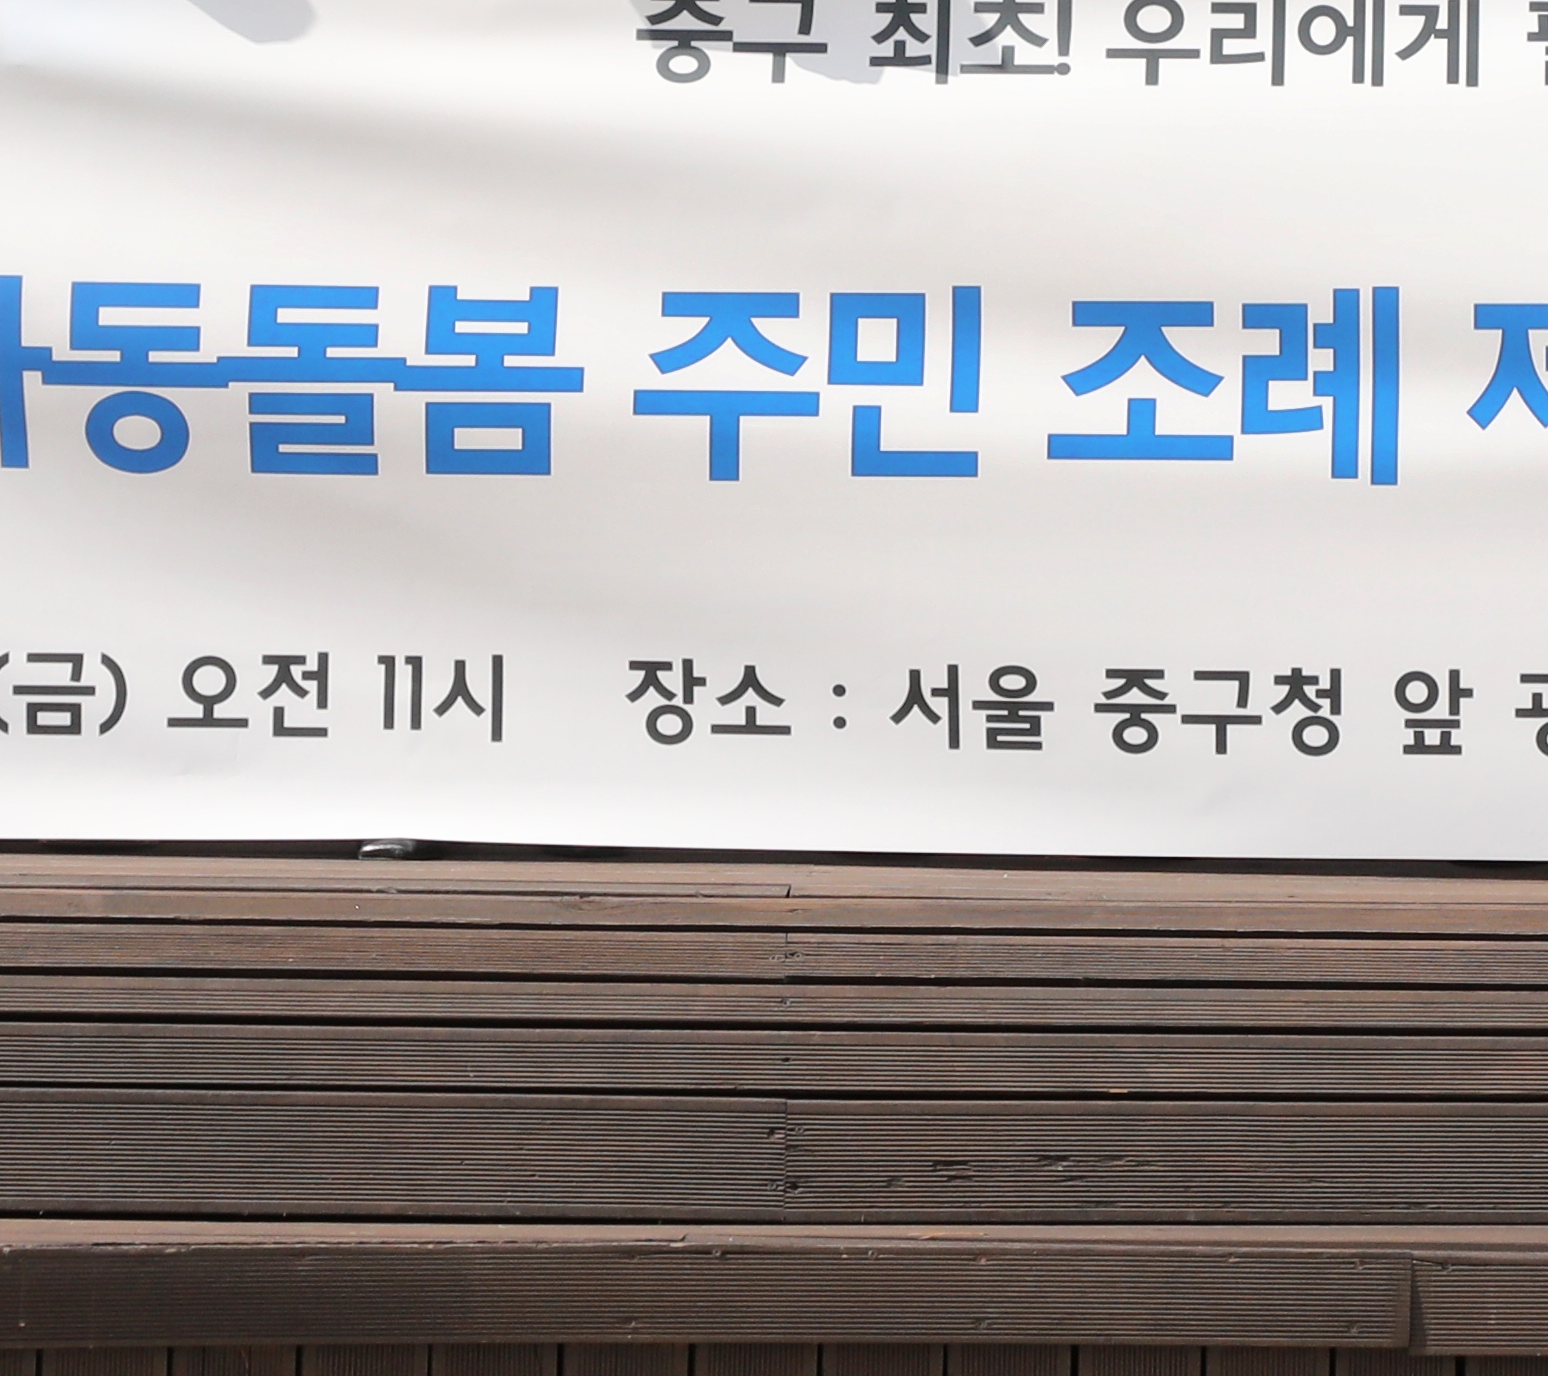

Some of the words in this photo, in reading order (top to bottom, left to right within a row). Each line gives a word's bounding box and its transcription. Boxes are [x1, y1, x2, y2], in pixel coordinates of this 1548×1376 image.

[635, 286, 981, 480] 주민
[1049, 287, 1399, 485] 조례
[168, 653, 328, 736] 오전
[378, 655, 503, 741] 11시
[627, 659, 791, 744] 장소
[833, 685, 846, 728] :
[891, 665, 1054, 750] 서울
[1095, 668, 1341, 756] 중구청
[1395, 670, 1473, 754] 앞
